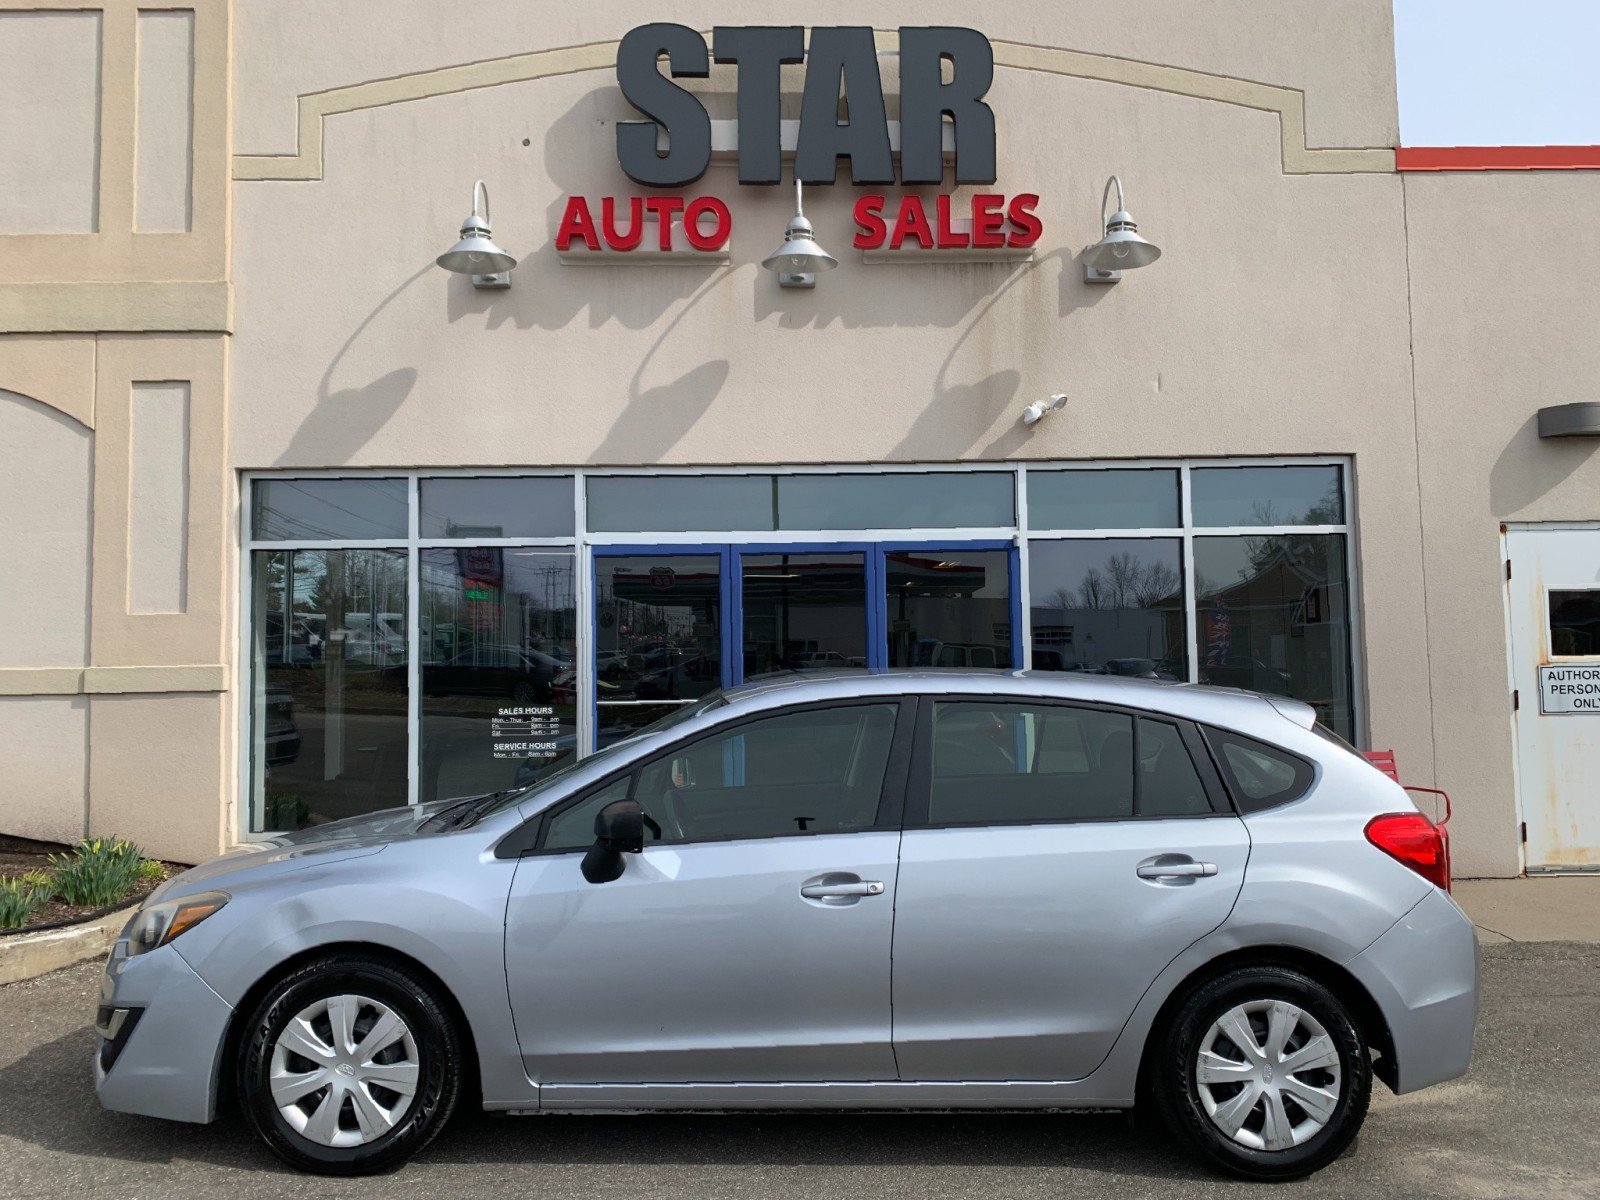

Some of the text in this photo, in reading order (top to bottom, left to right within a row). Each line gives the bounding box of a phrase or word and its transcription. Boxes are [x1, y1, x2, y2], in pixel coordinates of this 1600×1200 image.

[616, 22, 997, 188] STAR
[555, 193, 1043, 251] AUTO SALES
[498, 707, 523, 715] SALES
[1573, 698, 1600, 708] ONL
